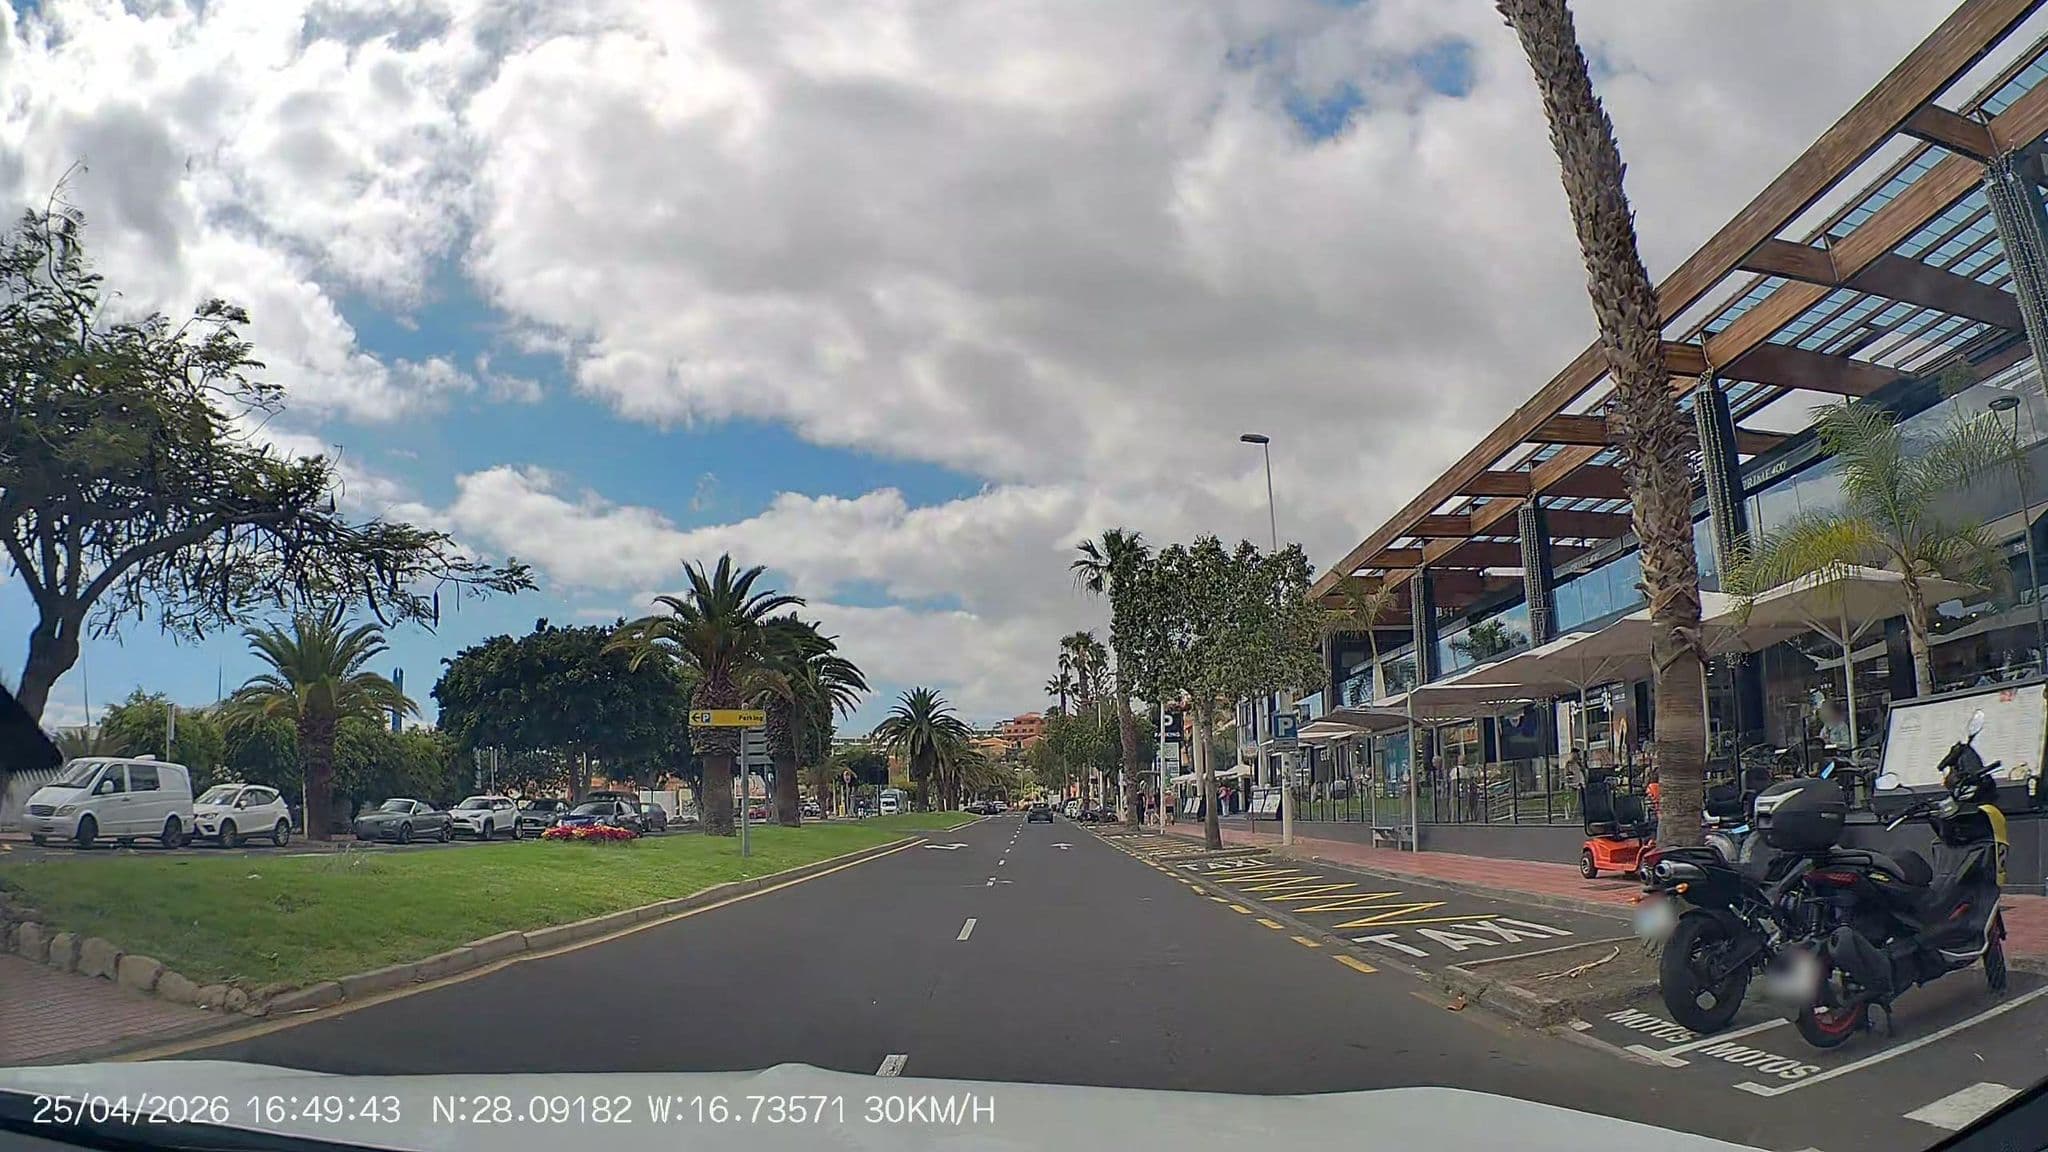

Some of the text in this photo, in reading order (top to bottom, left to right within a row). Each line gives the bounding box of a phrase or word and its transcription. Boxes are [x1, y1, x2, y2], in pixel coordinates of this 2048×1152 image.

[739, 713, 763, 721] Parking
[1278, 716, 1294, 737] P
[1352, 918, 1574, 957] TAXI
[1604, 1008, 1698, 1043] MOTOS
[1698, 1042, 1821, 1079] MOTOS
